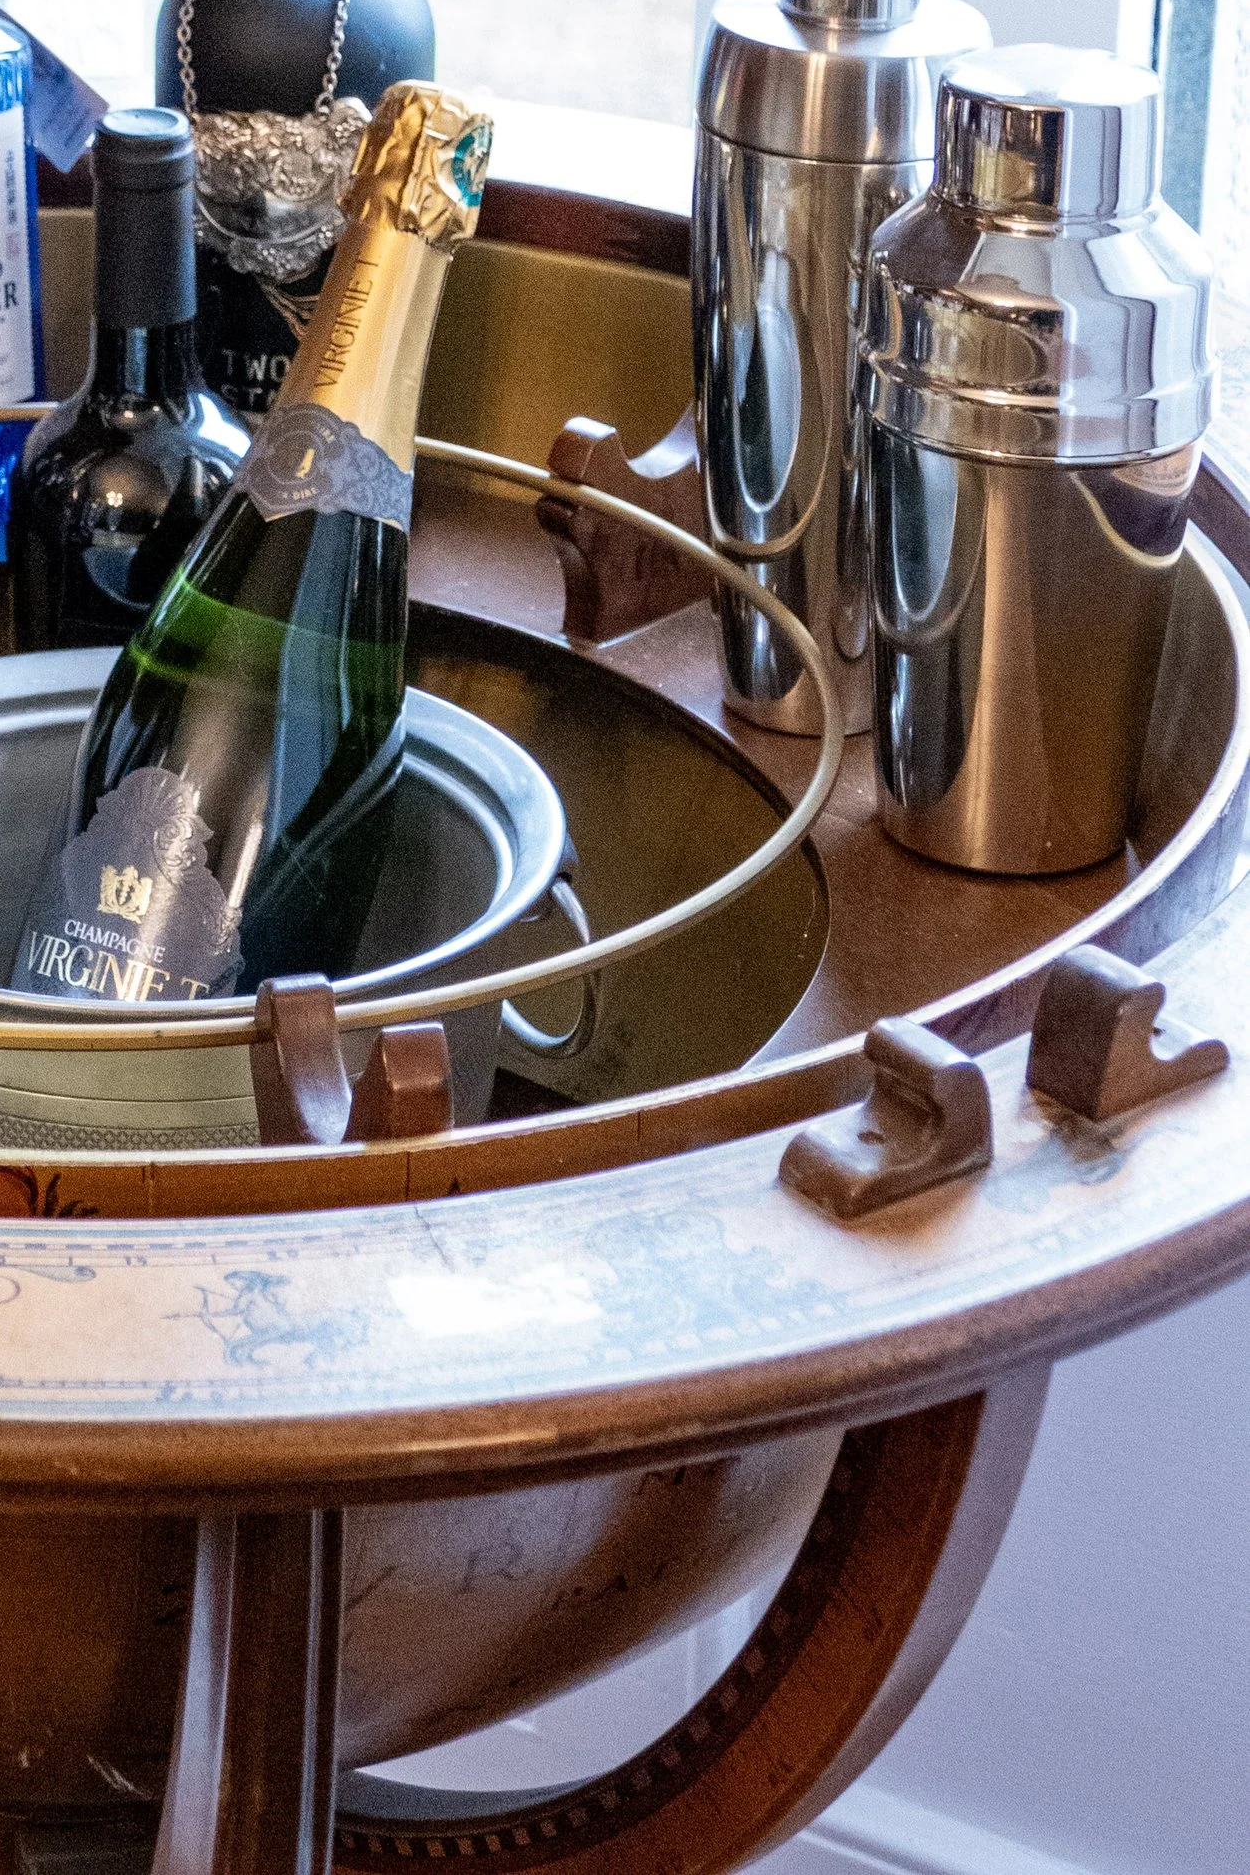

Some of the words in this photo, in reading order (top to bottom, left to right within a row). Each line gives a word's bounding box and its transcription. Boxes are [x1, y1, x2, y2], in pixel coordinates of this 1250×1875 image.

[312, 278, 374, 389] VIRGINIE
[222, 347, 292, 383] TWO
[64, 918, 167, 964] CHAMPAGNE
